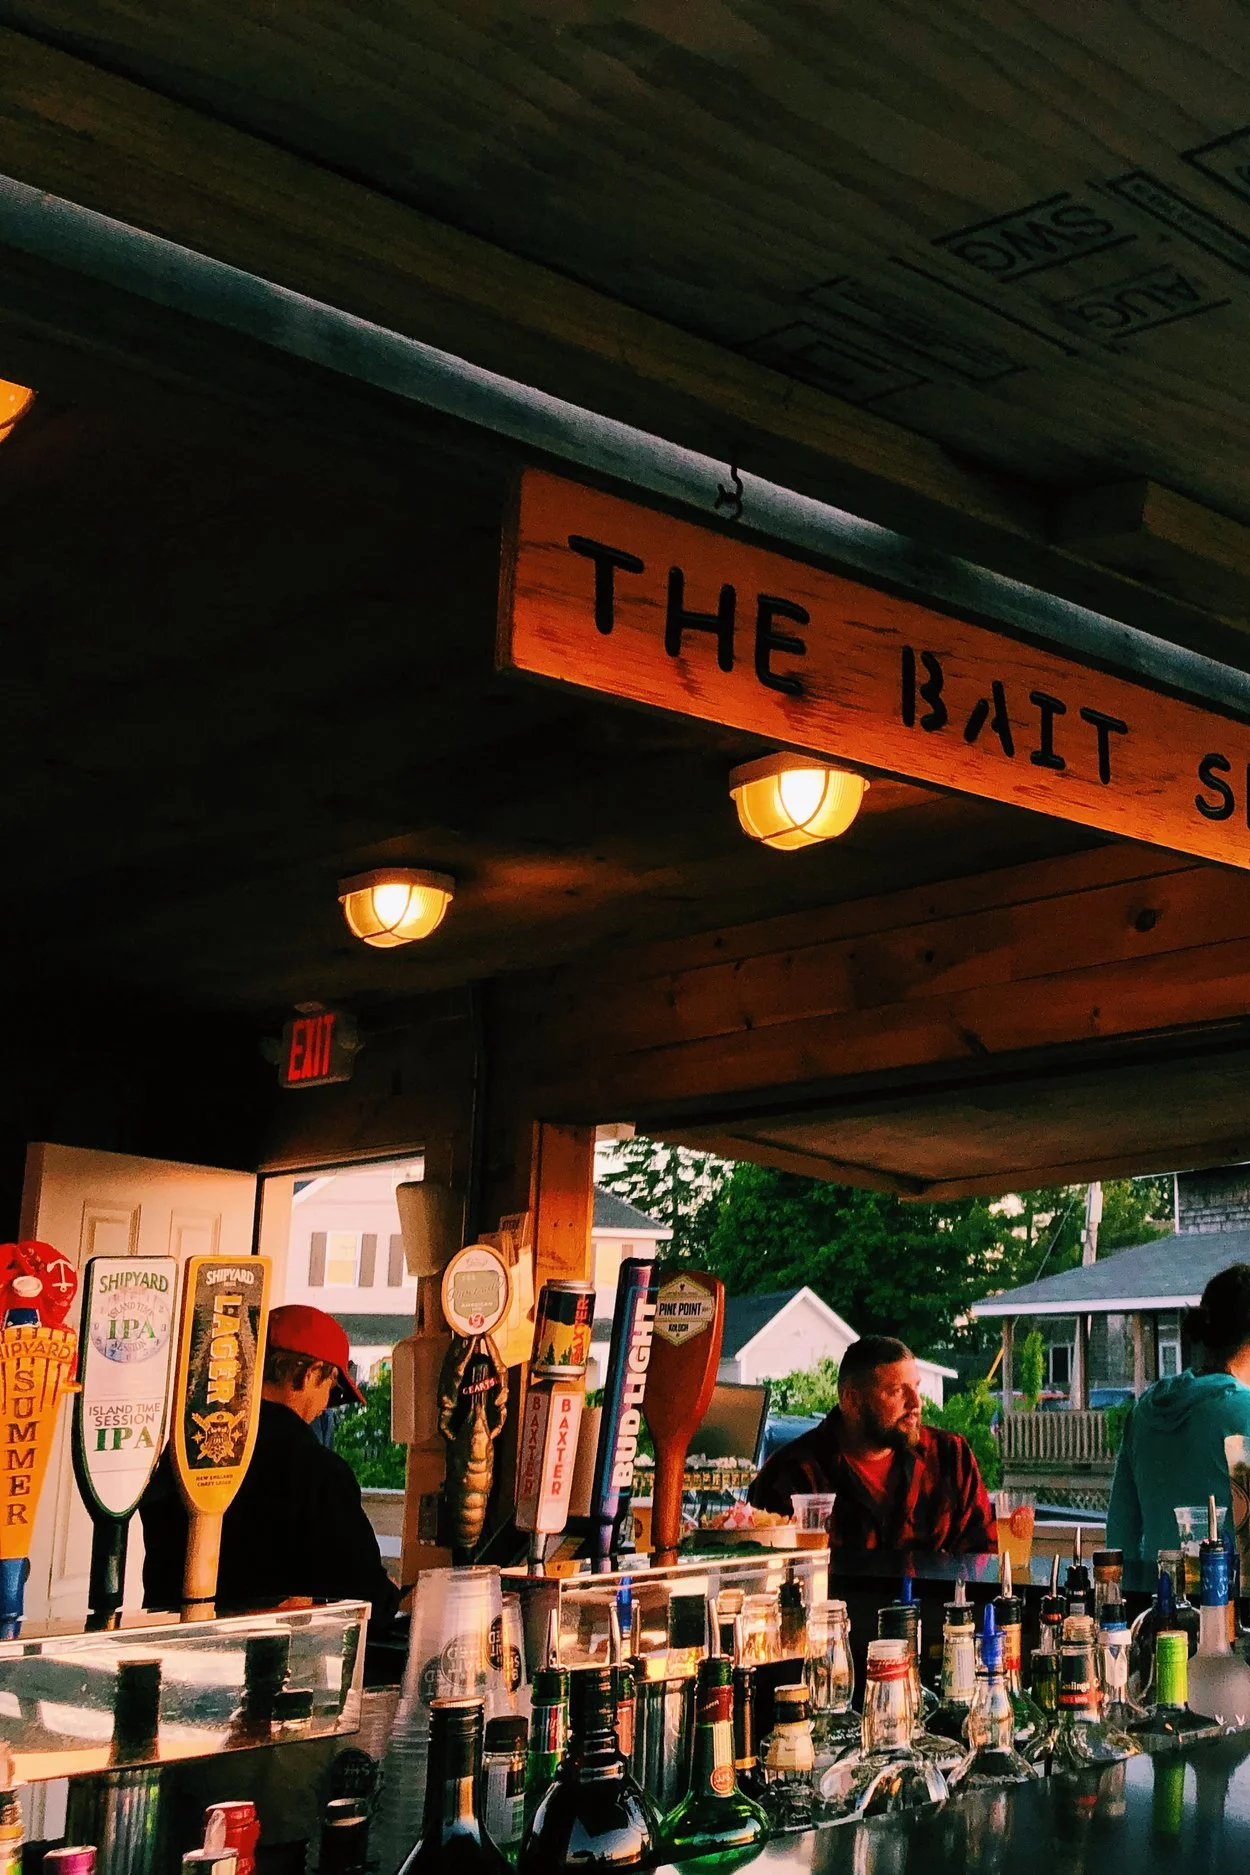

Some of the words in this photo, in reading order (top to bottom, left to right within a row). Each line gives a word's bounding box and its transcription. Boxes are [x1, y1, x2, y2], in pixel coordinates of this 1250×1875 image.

[953, 207, 1112, 272] SWG
[1078, 272, 1200, 329] AUG
[568, 535, 811, 694] THE
[901, 644, 1128, 784] BAIT
[288, 1012, 335, 1081] EXIT
[99, 1271, 169, 1293] SHIPYARD
[206, 1268, 255, 1285] SHIPYARD
[107, 1319, 156, 1340] IPA
[569, 1296, 590, 1365] BAXTER
[659, 1303, 677, 1316] PINE
[678, 1303, 702, 1316] POINT
[0, 1341, 71, 1359] IPYARD
[207, 1294, 243, 1404] LAGER
[623, 1297, 657, 1404] LIGHT
[88, 1404, 133, 1417] ISLAND
[136, 1402, 161, 1412] TIME
[93, 1425, 155, 1452] IPA
[95, 1413, 155, 1427] SESSION
[4, 1370, 40, 1527] SUMMER
[525, 1396, 542, 1496] BAXTER
[550, 1398, 572, 1496] BAXTER
[611, 1407, 641, 1488] BUD
